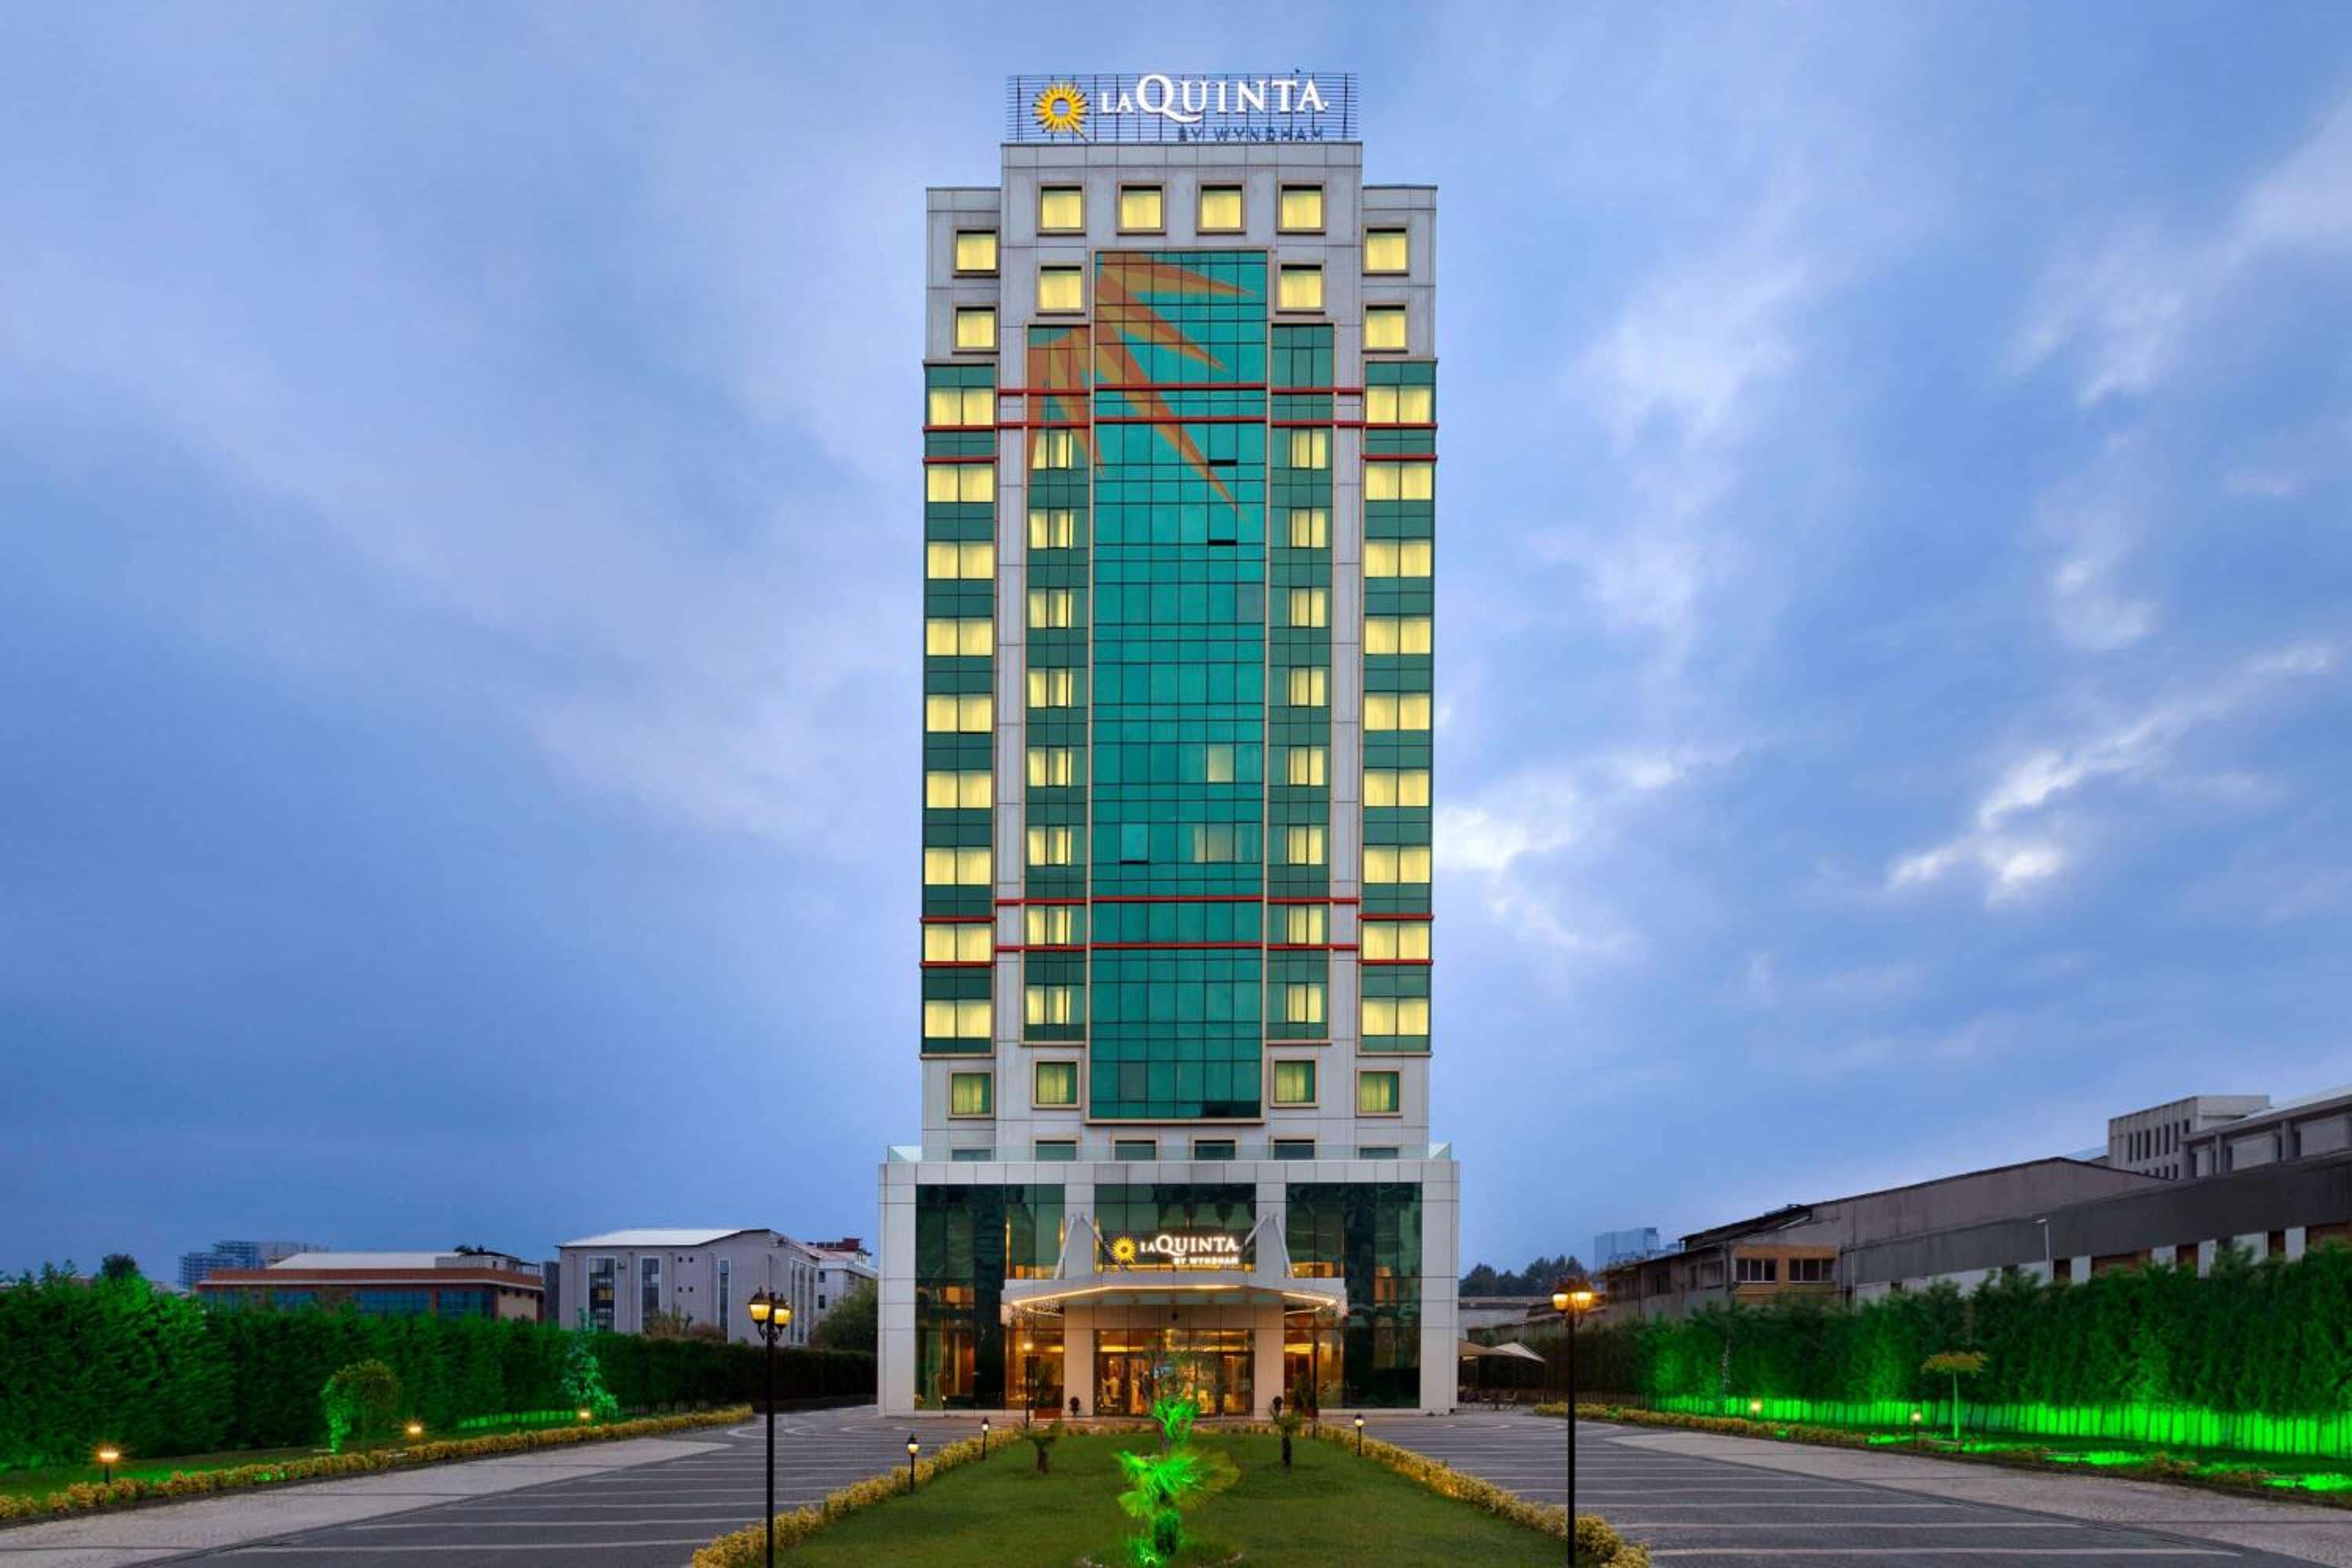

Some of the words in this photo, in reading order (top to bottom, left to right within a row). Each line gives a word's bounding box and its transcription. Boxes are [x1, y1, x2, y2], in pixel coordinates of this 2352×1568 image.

[1101, 91, 1133, 114] LA
[1136, 74, 1325, 123] QUINTA
[1178, 126, 1202, 142] BY
[1214, 126, 1323, 142] WYNDHAM
[1141, 1241, 1156, 1253] LA
[1156, 1235, 1237, 1256] QUINTA
[1173, 1256, 1186, 1265] BY
